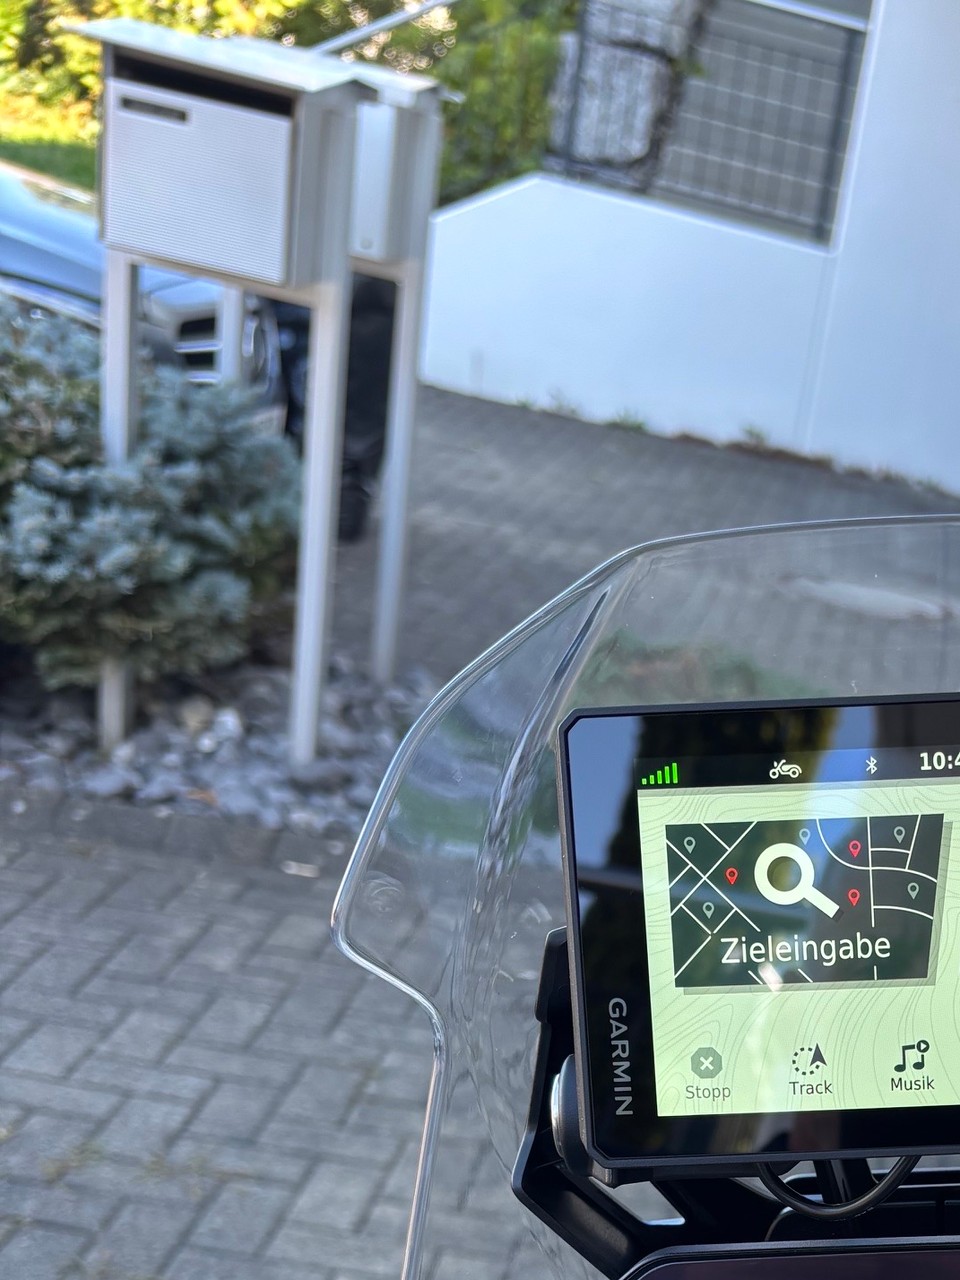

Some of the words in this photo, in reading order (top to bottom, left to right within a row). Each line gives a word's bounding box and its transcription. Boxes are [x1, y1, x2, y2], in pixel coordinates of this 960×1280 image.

[720, 931, 892, 966] Zieleingabe
[608, 997, 634, 1116] GARMIN
[788, 1079, 833, 1096] Track
[890, 1075, 935, 1092] Musik
[685, 1085, 731, 1102] Stopp
